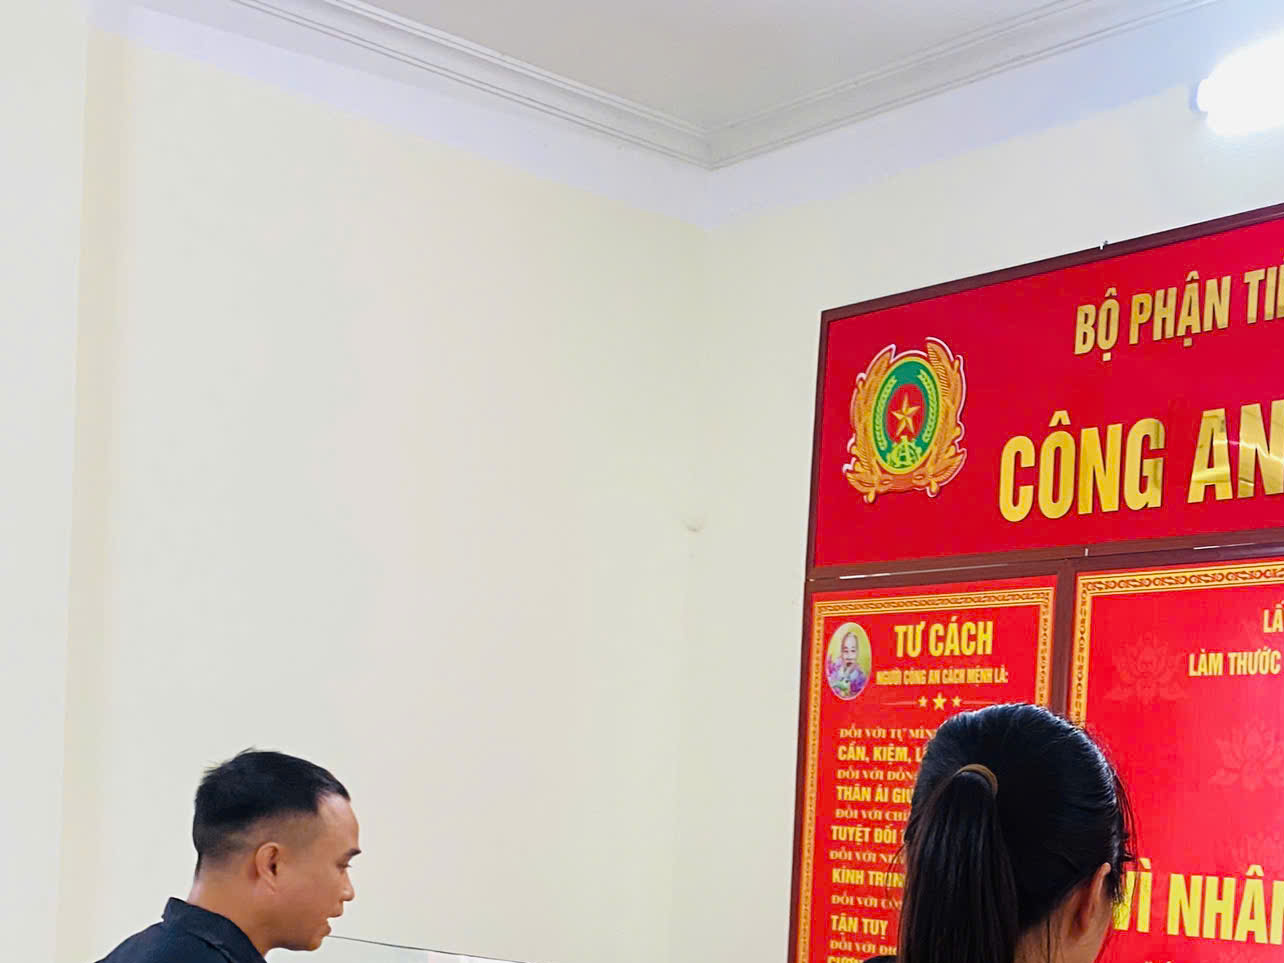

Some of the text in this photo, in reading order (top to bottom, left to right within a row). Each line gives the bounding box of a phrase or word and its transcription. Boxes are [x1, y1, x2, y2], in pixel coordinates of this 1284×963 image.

[1074, 288, 1118, 361] BỘ
[1130, 271, 1231, 346] PHẬN
[1000, 410, 1165, 523] CÔNG
[894, 616, 993, 657] TƯ CÁCH
[1186, 648, 1225, 677] LÀM
[1228, 643, 1282, 675] THƯỚC
[836, 783, 872, 802] THÂN
[831, 824, 871, 845] TUYỆT
[832, 865, 865, 885] KÍNH
